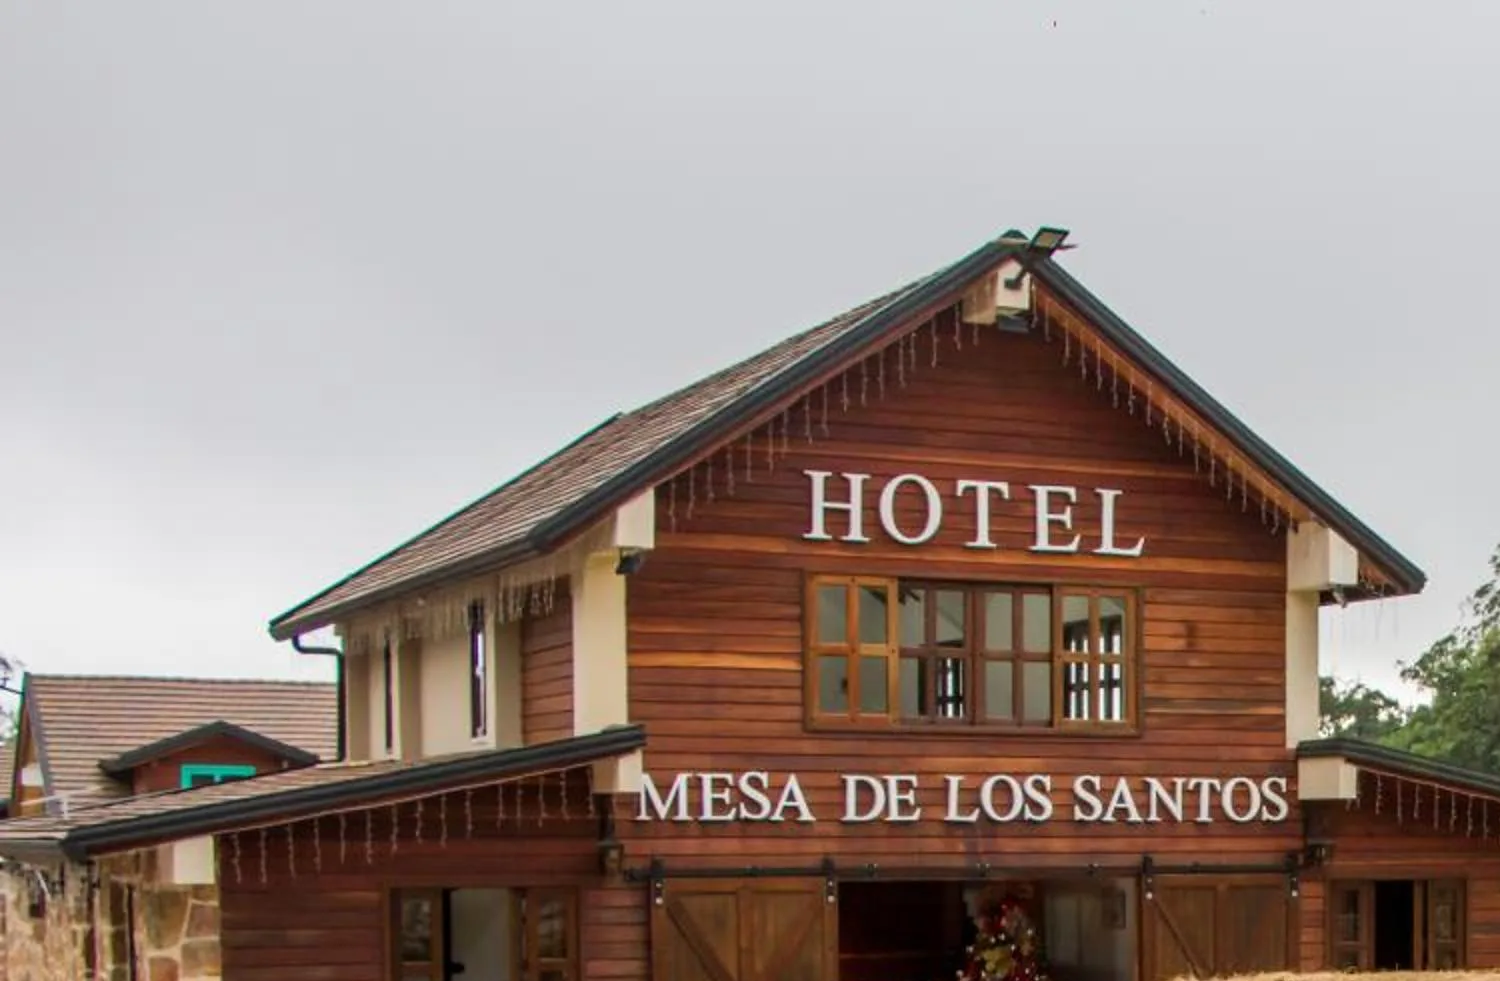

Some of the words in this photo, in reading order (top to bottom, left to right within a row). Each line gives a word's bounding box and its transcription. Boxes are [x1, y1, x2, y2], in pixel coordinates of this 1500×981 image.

[803, 470, 1145, 557] HOTEL
[636, 771, 816, 822] MESA
[841, 775, 922, 822] DE
[944, 774, 1053, 823] LOS
[1073, 775, 1289, 823] SANTOS
